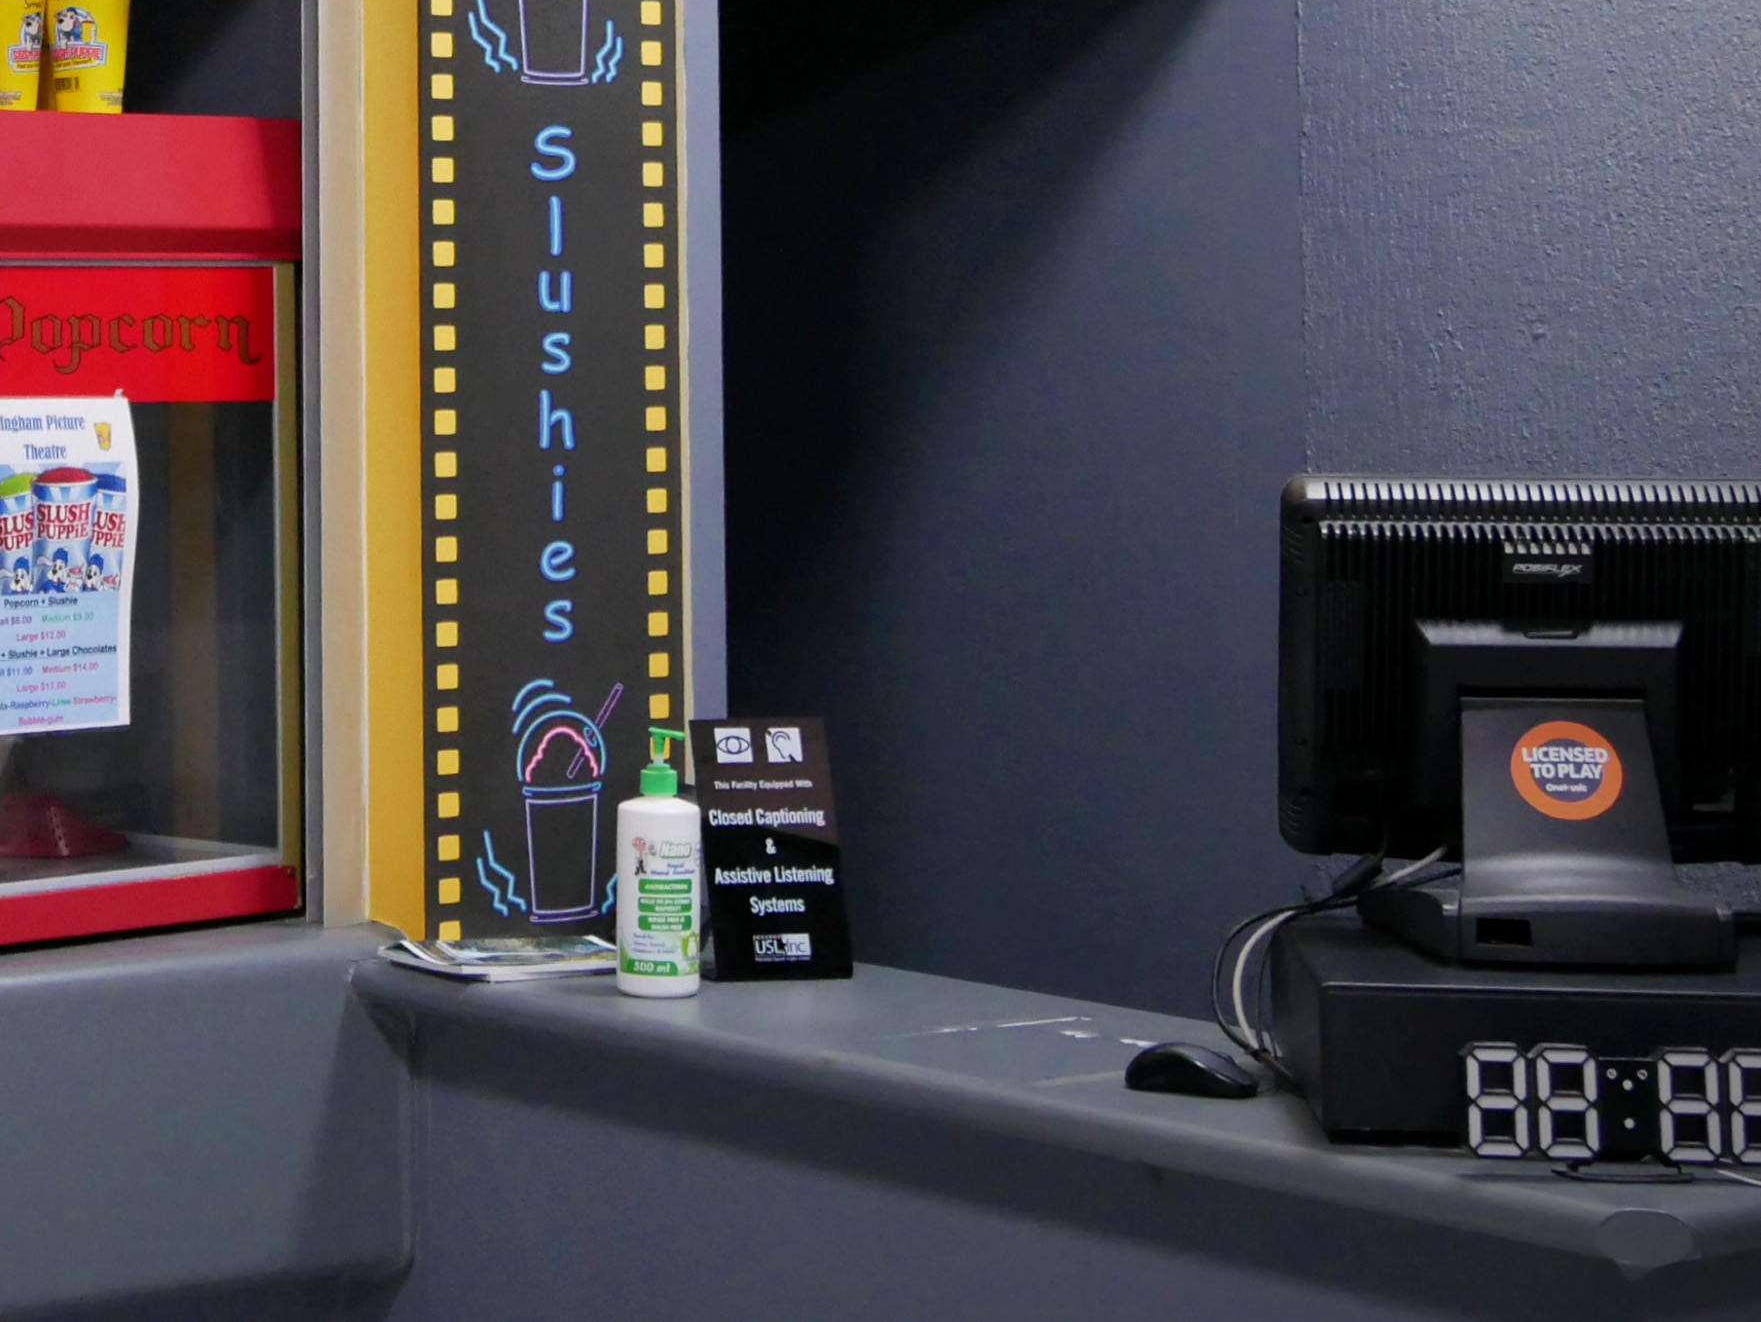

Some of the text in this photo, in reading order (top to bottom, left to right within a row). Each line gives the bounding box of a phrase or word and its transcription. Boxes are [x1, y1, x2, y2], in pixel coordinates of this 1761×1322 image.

[530, 124, 576, 642] Slushies
[0, 414, 86, 433] Ingham Picture
[24, 444, 67, 460] Theatre
[36, 502, 91, 523] SLUSH
[1512, 563, 1582, 578] POSIFLEX
[4, 598, 39, 609] Popcorn
[48, 595, 78, 606] Slushie
[16, 632, 39, 643] Large
[8, 648, 38, 659] Slushie
[47, 646, 70, 657] Large
[72, 644, 117, 654] Chocolates
[42, 664, 71, 674] Medium
[16, 683, 39, 694] Large
[1522, 747, 1608, 763] LICENSED
[1530, 763, 1602, 779] TO PLAY
[714, 780, 813, 790] This Facility Equipped With
[709, 807, 826, 827] Closed Captioning
[660, 843, 691, 858] Nano
[765, 838, 776, 854] &
[714, 866, 835, 885] Assistive Listening
[750, 896, 805, 916] Systems
[634, 962, 670, 972] 500 ml
